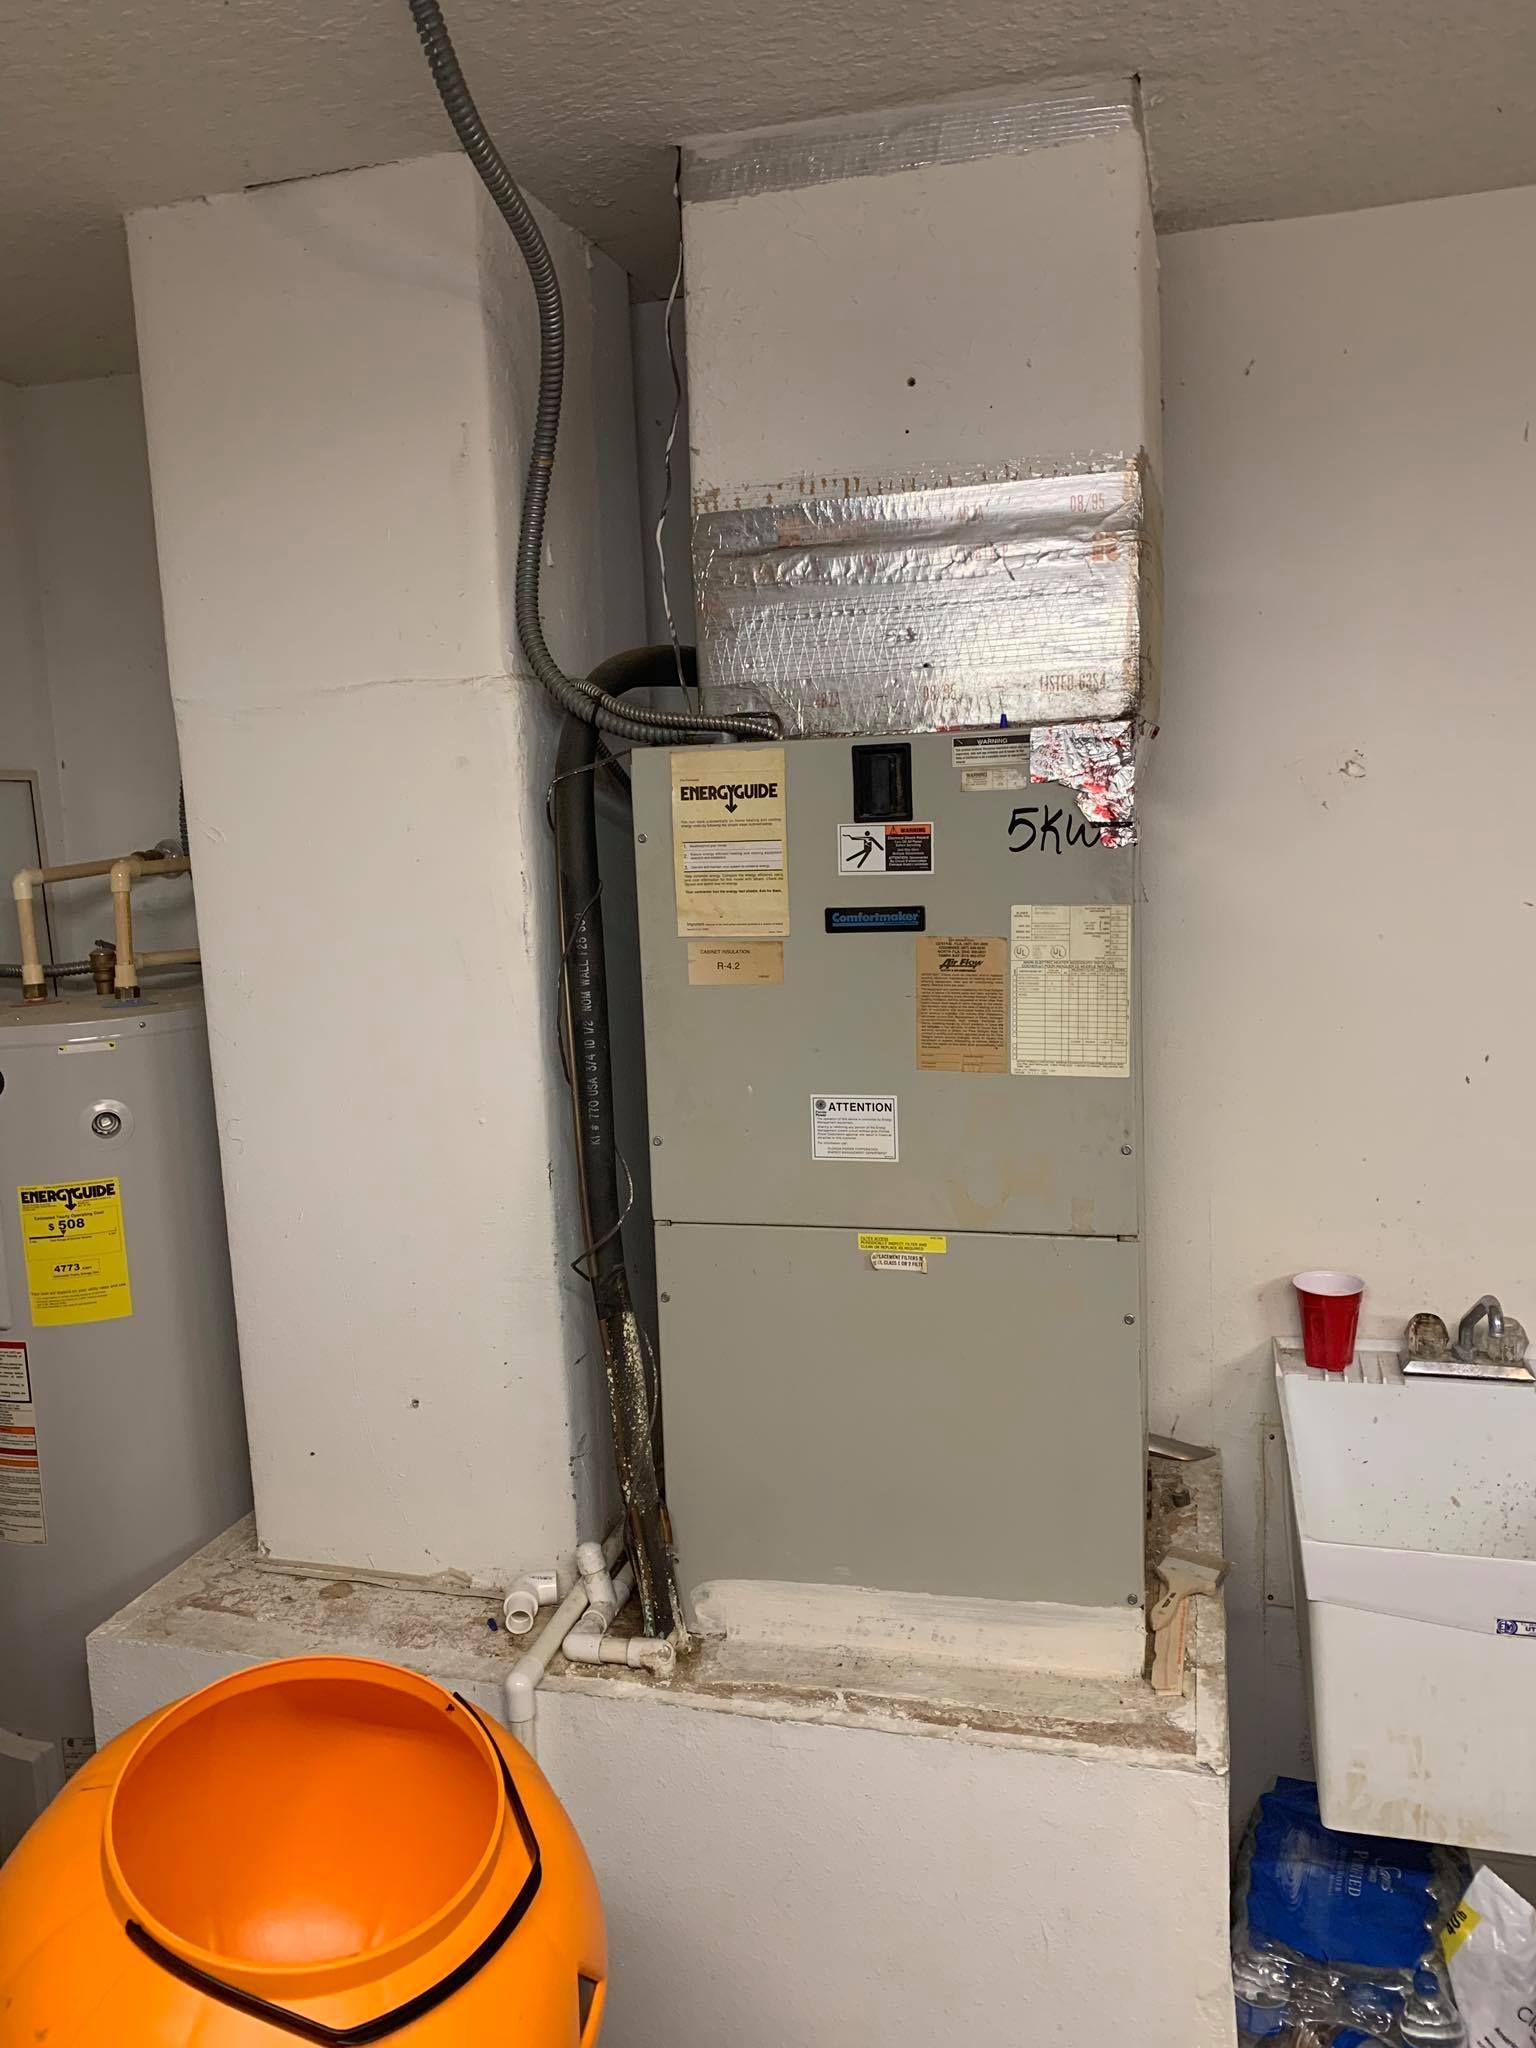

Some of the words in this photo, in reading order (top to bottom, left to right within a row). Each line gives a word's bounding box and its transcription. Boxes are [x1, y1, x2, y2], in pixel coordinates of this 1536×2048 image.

[1041, 675, 1074, 692] LISTED
[976, 738, 1008, 746] WARNING
[680, 783, 778, 801] ENERGYGUIDE
[832, 911, 919, 923] Comfortmaker
[717, 961, 740, 970] R-4.2
[959, 958, 984, 968] Flow
[579, 959, 591, 986] WALL
[581, 990, 592, 1012] NOM
[585, 1053, 597, 1072] 3/4
[587, 1076, 599, 1096] USA
[588, 1100, 600, 1119] 770
[828, 1102, 892, 1112] ATTENTION
[20, 1183, 116, 1204] ENERGYGUIDE
[48, 1223, 55, 1231] $
[58, 1218, 85, 1230] 508
[54, 1263, 80, 1273] 4773
